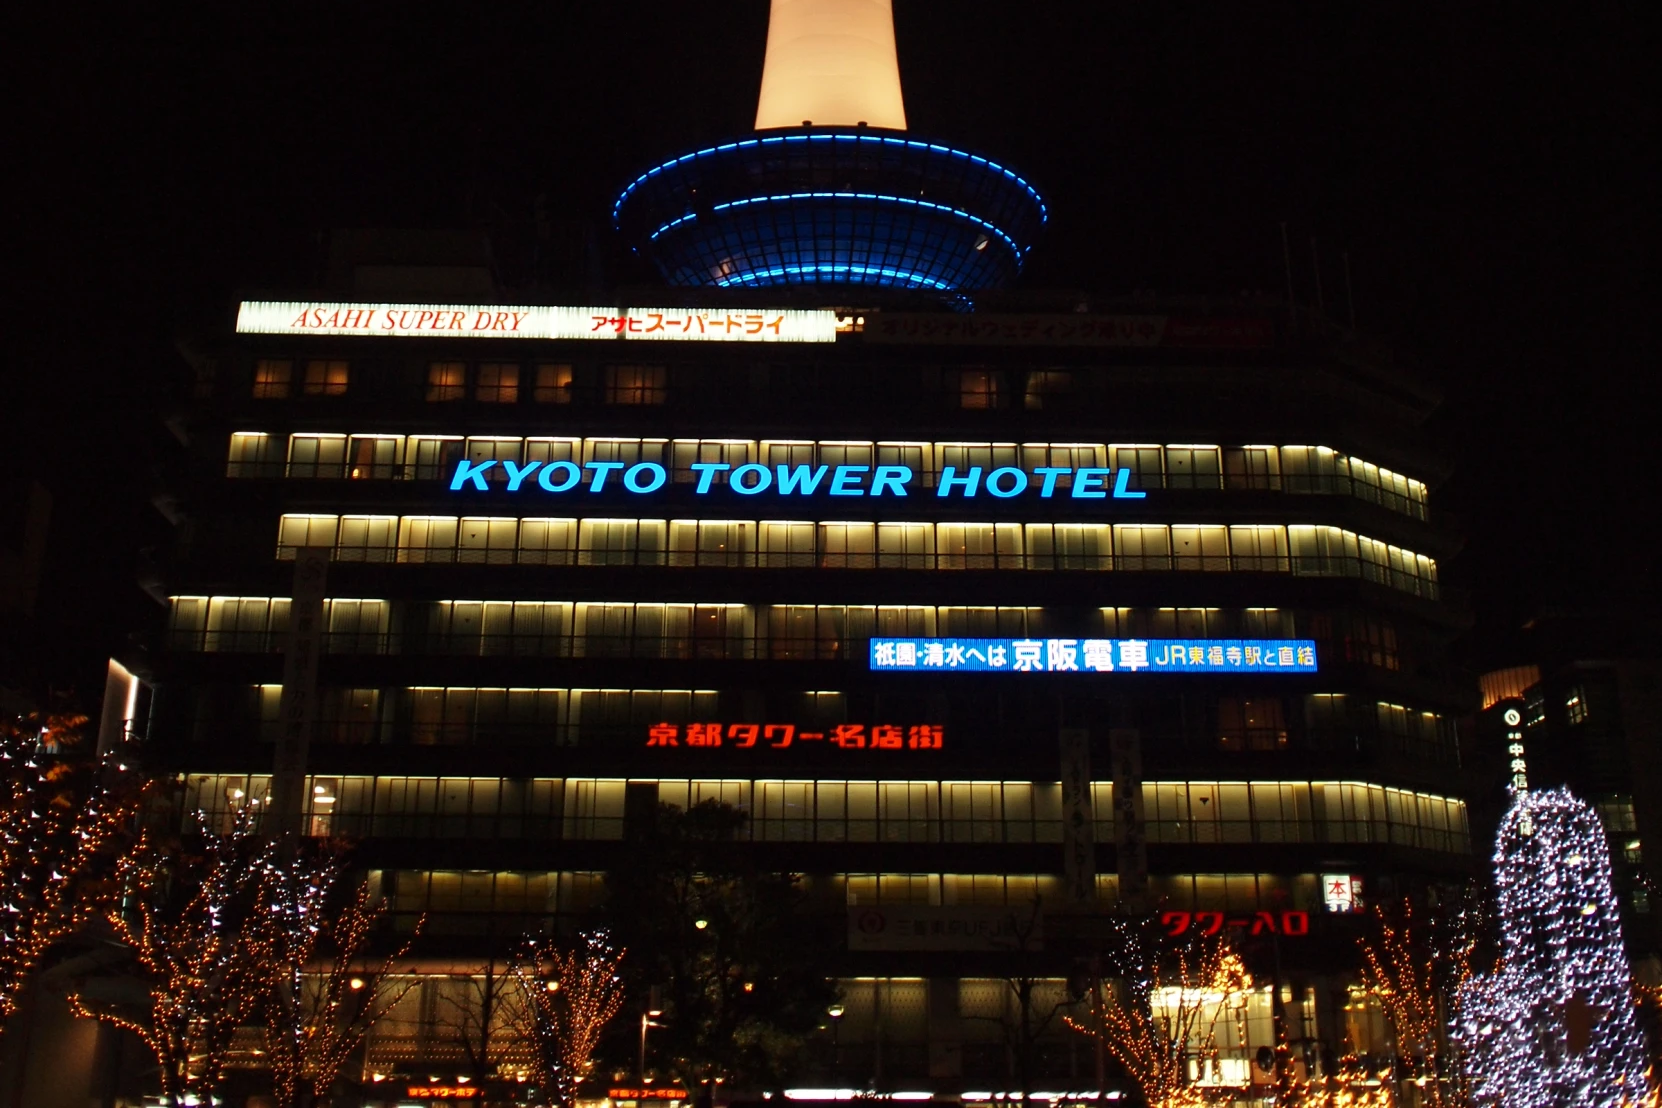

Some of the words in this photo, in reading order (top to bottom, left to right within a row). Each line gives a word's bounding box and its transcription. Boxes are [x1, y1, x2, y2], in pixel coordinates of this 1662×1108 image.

[291, 307, 377, 329] ASAHI
[381, 309, 466, 330] SUPER
[471, 311, 530, 332] DRY
[591, 312, 785, 335] アサヒスーパードライ
[450, 460, 666, 493] KYOTO
[691, 464, 912, 496] TOWER
[937, 467, 1146, 498] HOTEL
[1011, 638, 1149, 671] 京阪電車
[1155, 645, 1315, 666] JR東福寺駅と直結
[646, 722, 944, 749] 京都タワー名店街
[1328, 879, 1347, 898] 本
[1161, 911, 1309, 937] タワー入口
